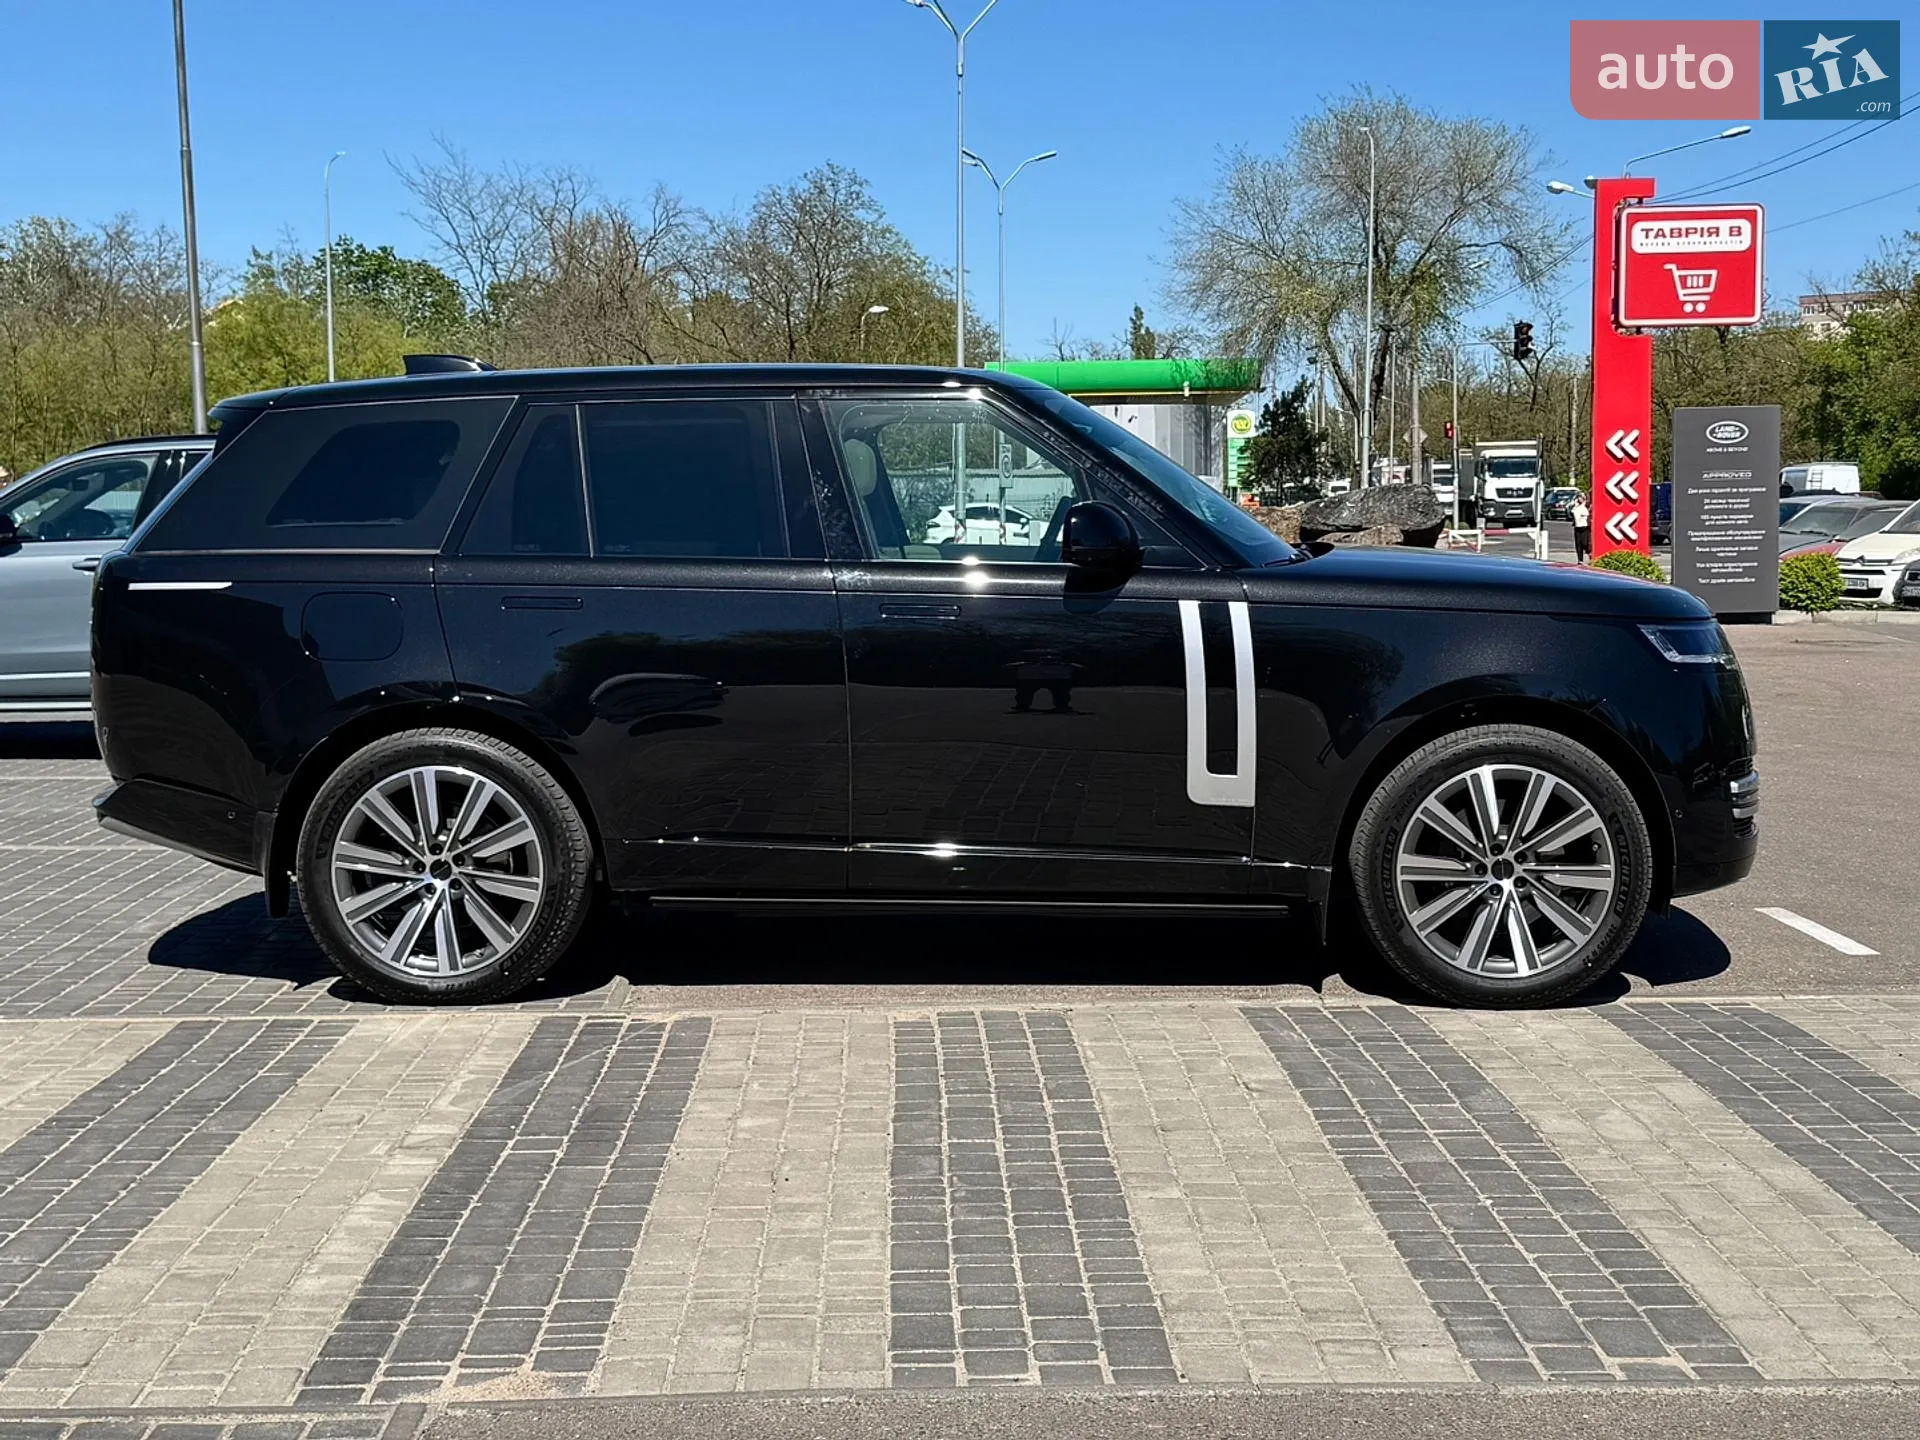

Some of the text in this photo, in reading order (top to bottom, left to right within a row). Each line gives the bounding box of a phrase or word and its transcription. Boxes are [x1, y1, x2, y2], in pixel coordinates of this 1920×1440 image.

[1640, 225, 1743, 239] ТАВРІЯ В
[1702, 471, 1753, 479] APPROVED
[1382, 829, 1398, 910] MICHELIN
[1614, 832, 1631, 914] MICHELIN
